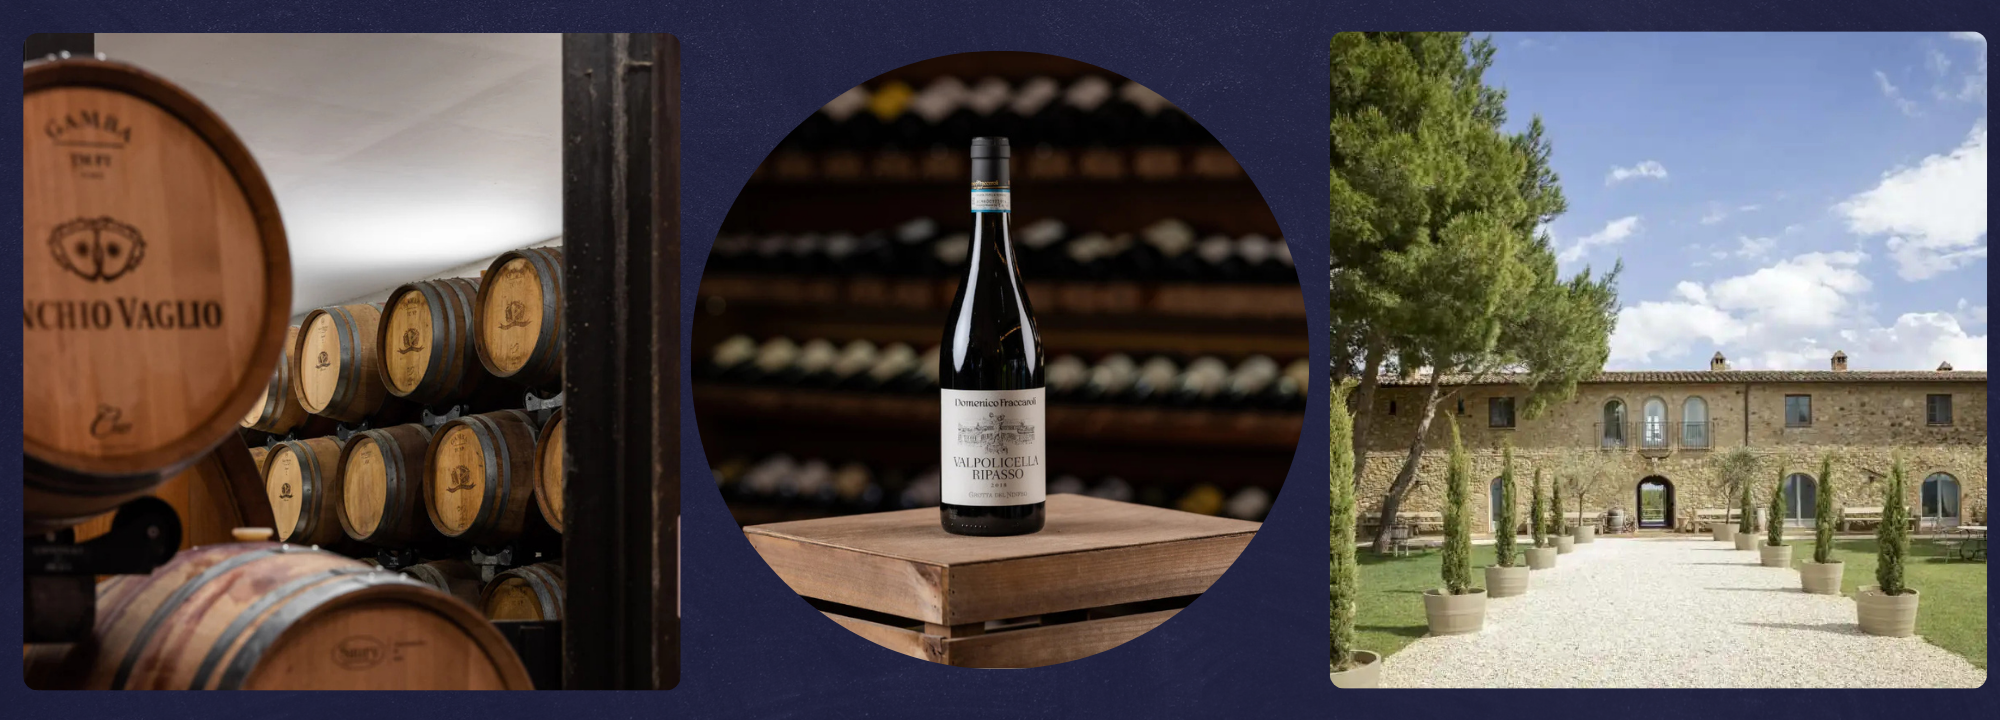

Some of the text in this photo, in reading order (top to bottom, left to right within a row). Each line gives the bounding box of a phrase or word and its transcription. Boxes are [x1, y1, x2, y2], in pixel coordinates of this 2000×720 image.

[44, 109, 132, 144] GAMBA
[116, 297, 222, 330] VAGLIO
[954, 397, 1037, 408] Domenico Fraccaroli
[953, 455, 1039, 468] VALPOLICELLA
[972, 468, 1024, 480] RIPASSO
